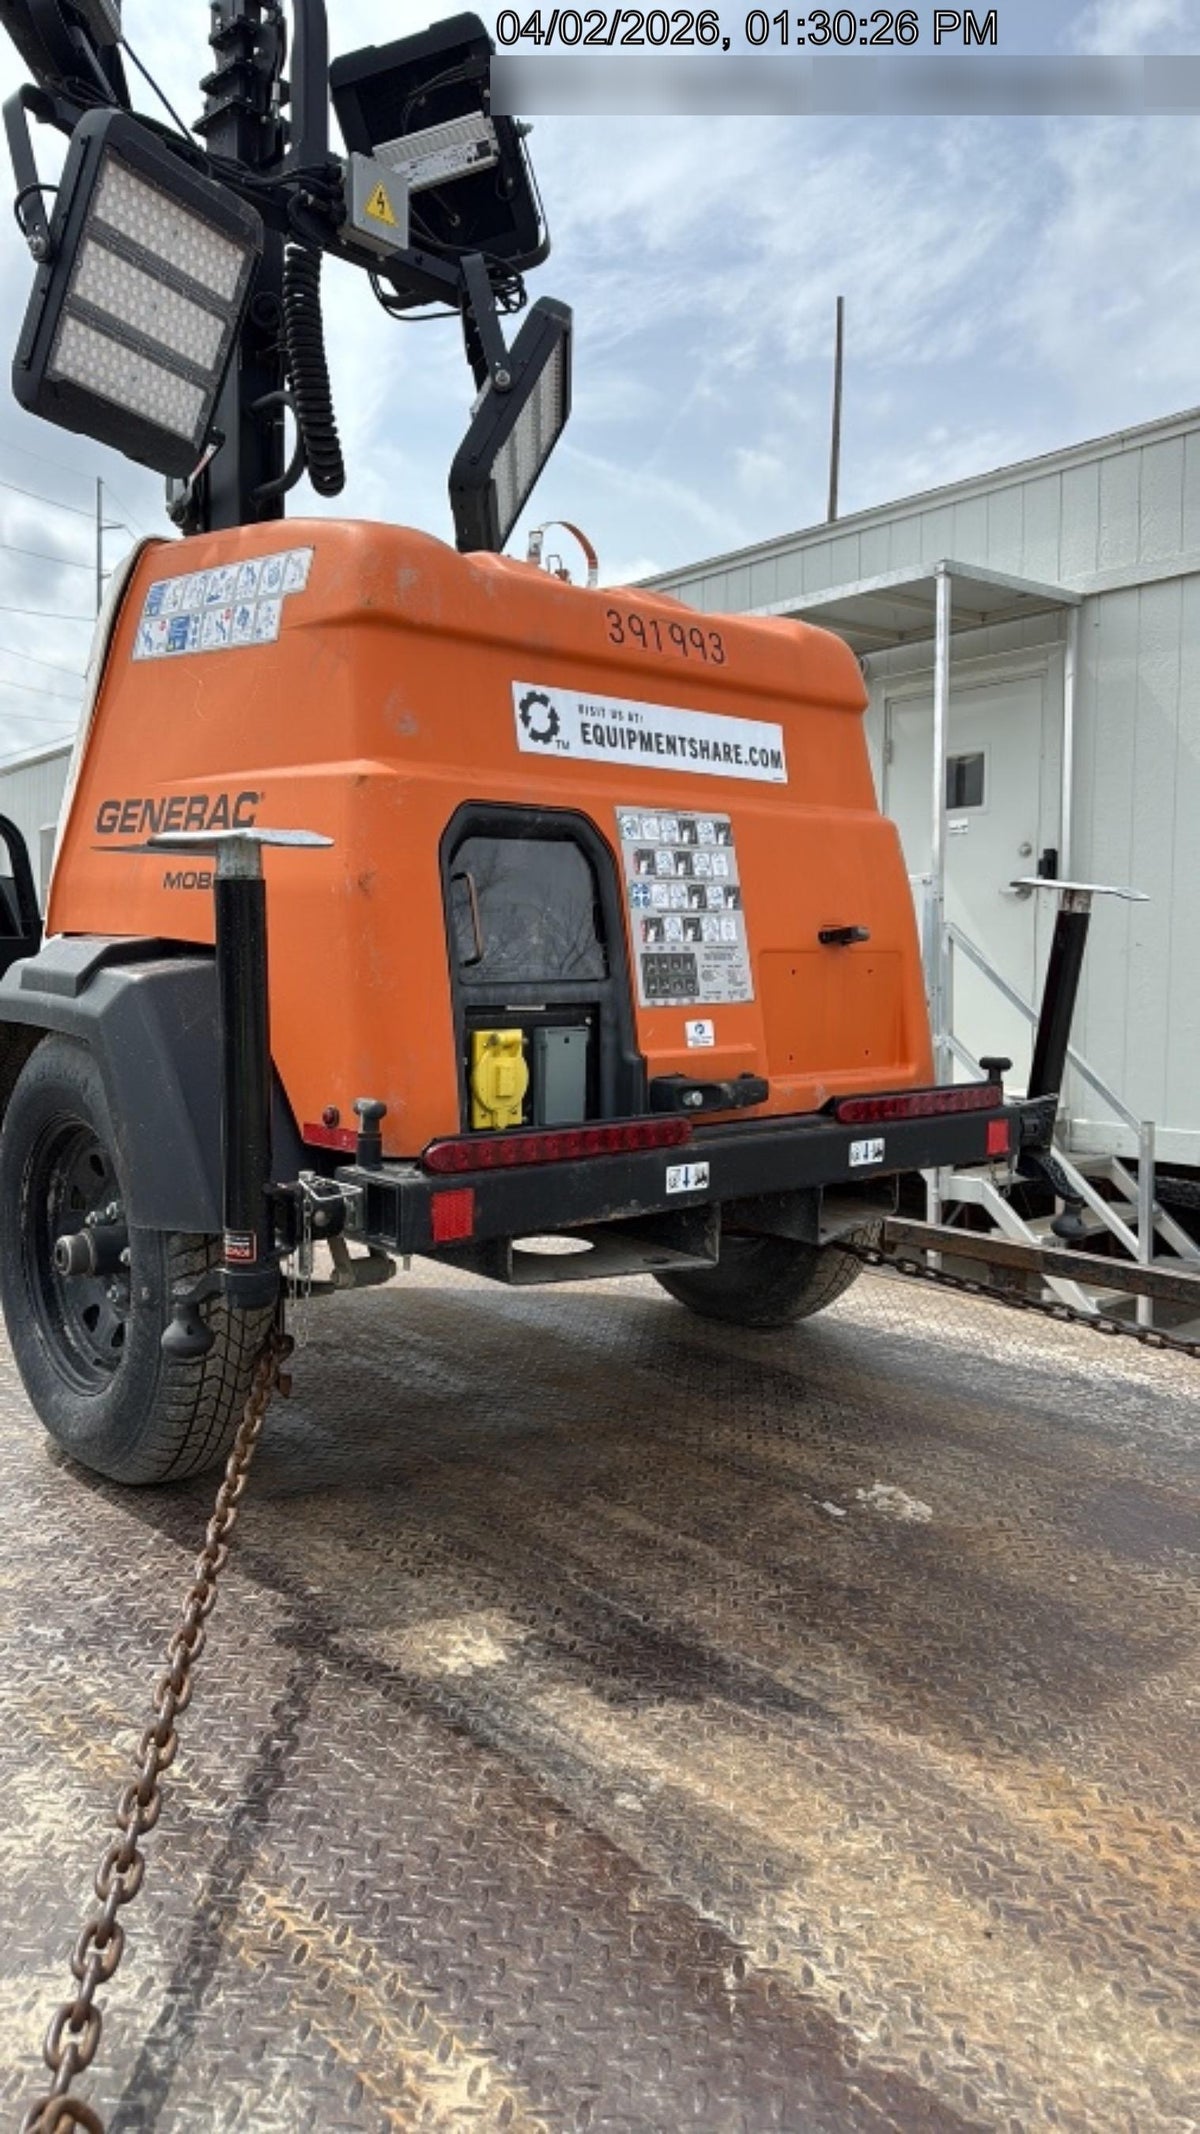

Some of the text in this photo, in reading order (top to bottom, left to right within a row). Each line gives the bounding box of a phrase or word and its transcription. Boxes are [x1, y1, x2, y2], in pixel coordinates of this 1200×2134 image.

[606, 609, 725, 664] 391993
[578, 703, 606, 719] VISIT
[580, 721, 783, 770] EQUIPMENTSHARE.COM
[163, 871, 214, 889] MOB
